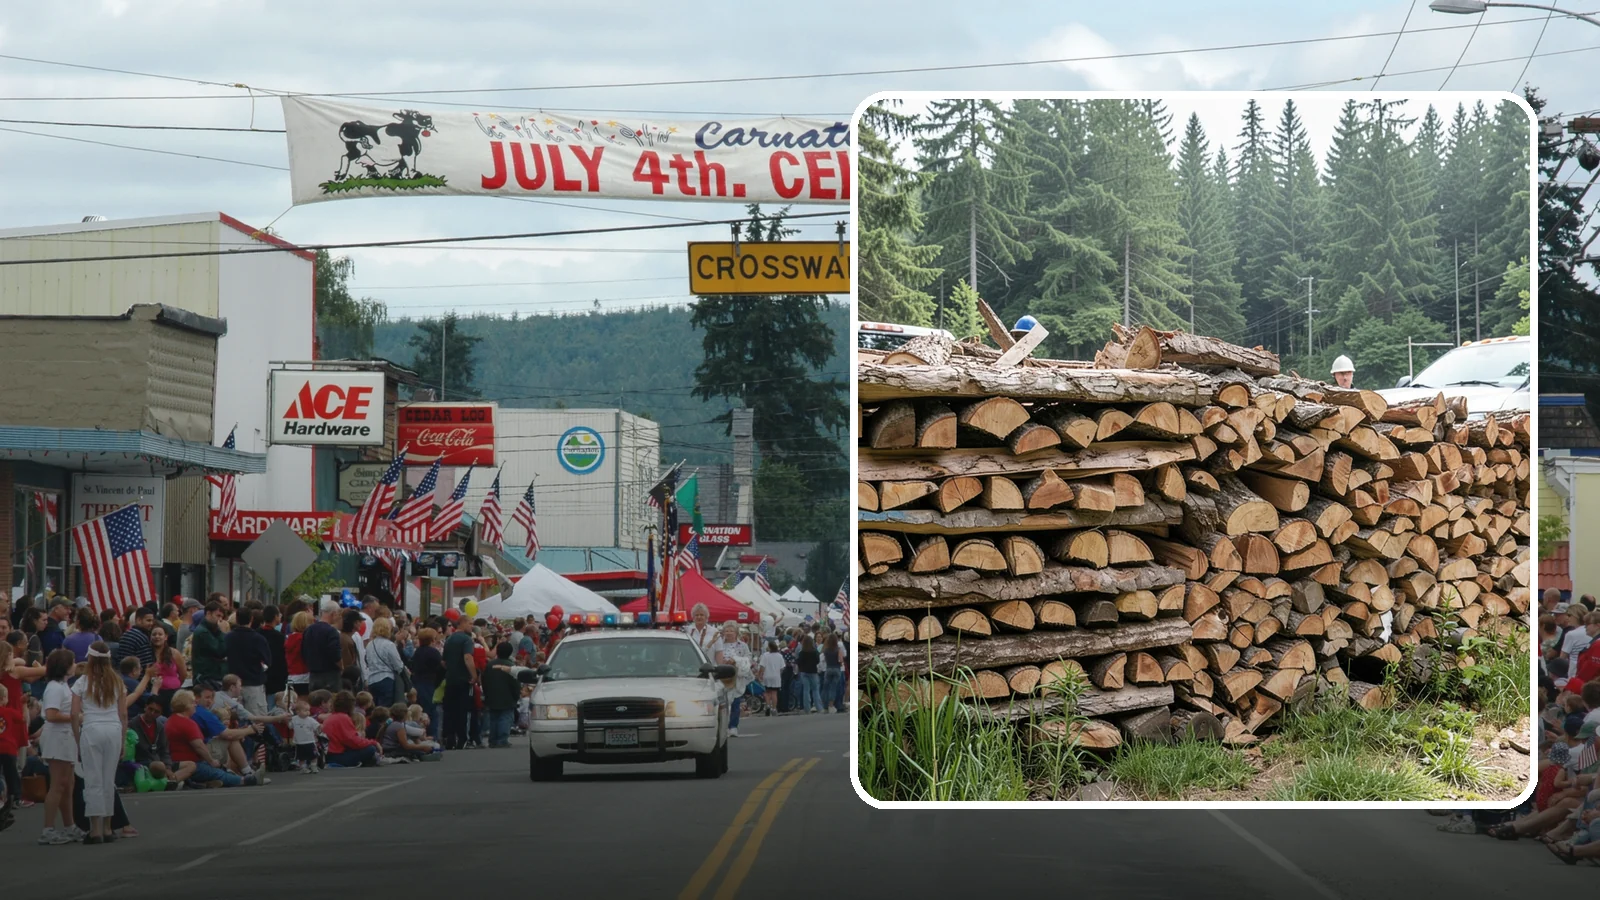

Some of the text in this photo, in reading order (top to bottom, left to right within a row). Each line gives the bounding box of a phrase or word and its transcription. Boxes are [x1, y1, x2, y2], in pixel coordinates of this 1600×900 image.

[694, 121, 850, 150] Carnat
[481, 141, 605, 193] JULY
[632, 149, 747, 198] 4th.
[697, 254, 850, 280] CROSSWA
[283, 380, 374, 420] ACE
[405, 409, 452, 422] CEDAR
[283, 421, 371, 436] Hardware
[416, 428, 477, 447] Coca-Cola
[353, 466, 386, 481] Simpl
[83, 485, 155, 495] St. Vincent de Paul
[688, 526, 742, 536] CRNATION
[699, 535, 730, 544] GLASS
